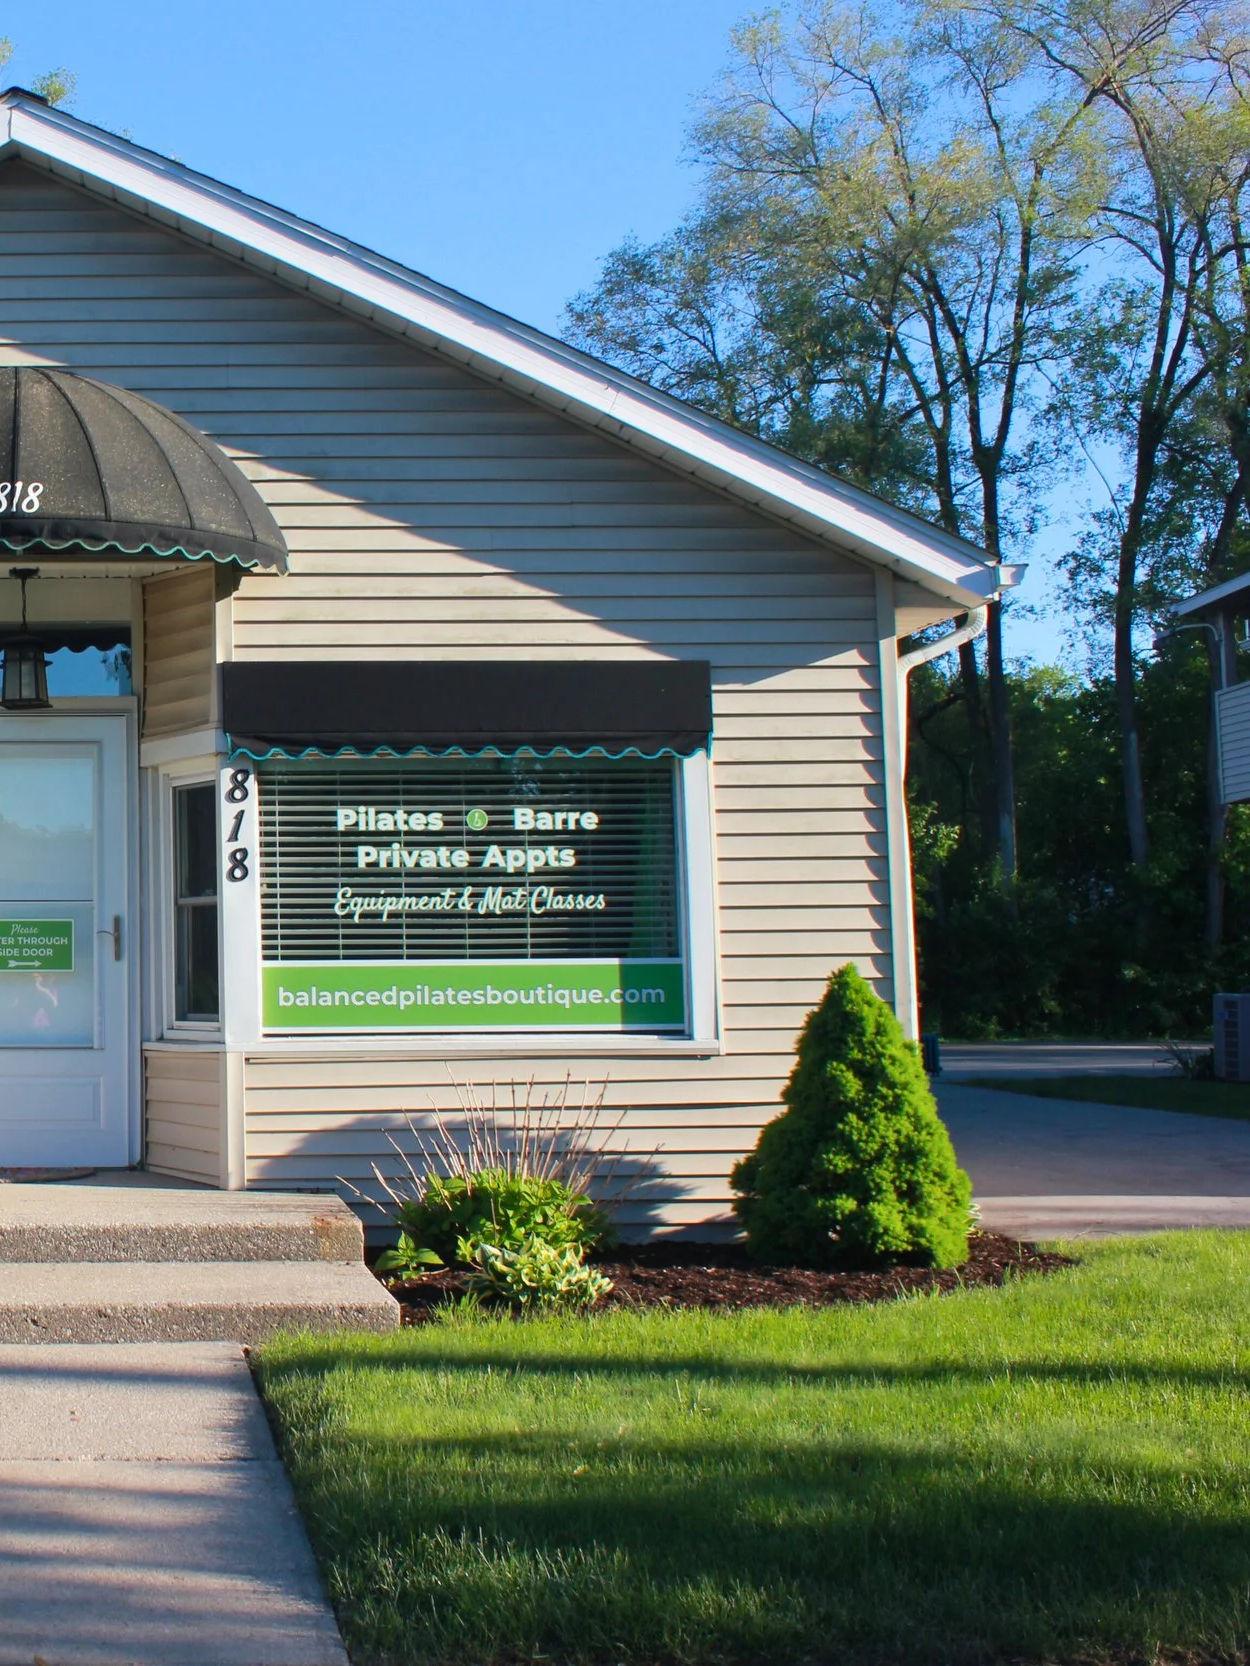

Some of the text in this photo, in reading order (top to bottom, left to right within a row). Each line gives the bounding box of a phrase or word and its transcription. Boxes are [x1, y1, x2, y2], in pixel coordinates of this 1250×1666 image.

[225, 768, 250, 883] 818
[336, 806, 444, 831] Pilates
[514, 808, 599, 831] Barre
[357, 842, 576, 873] Private Appts
[334, 886, 606, 923] Equipment & Mat Classes
[11, 923, 39, 936] Please
[17, 936, 68, 945] THROUGH
[22, 947, 53, 957] DOOR
[278, 984, 666, 1009] balancedpilatesboutique.com
